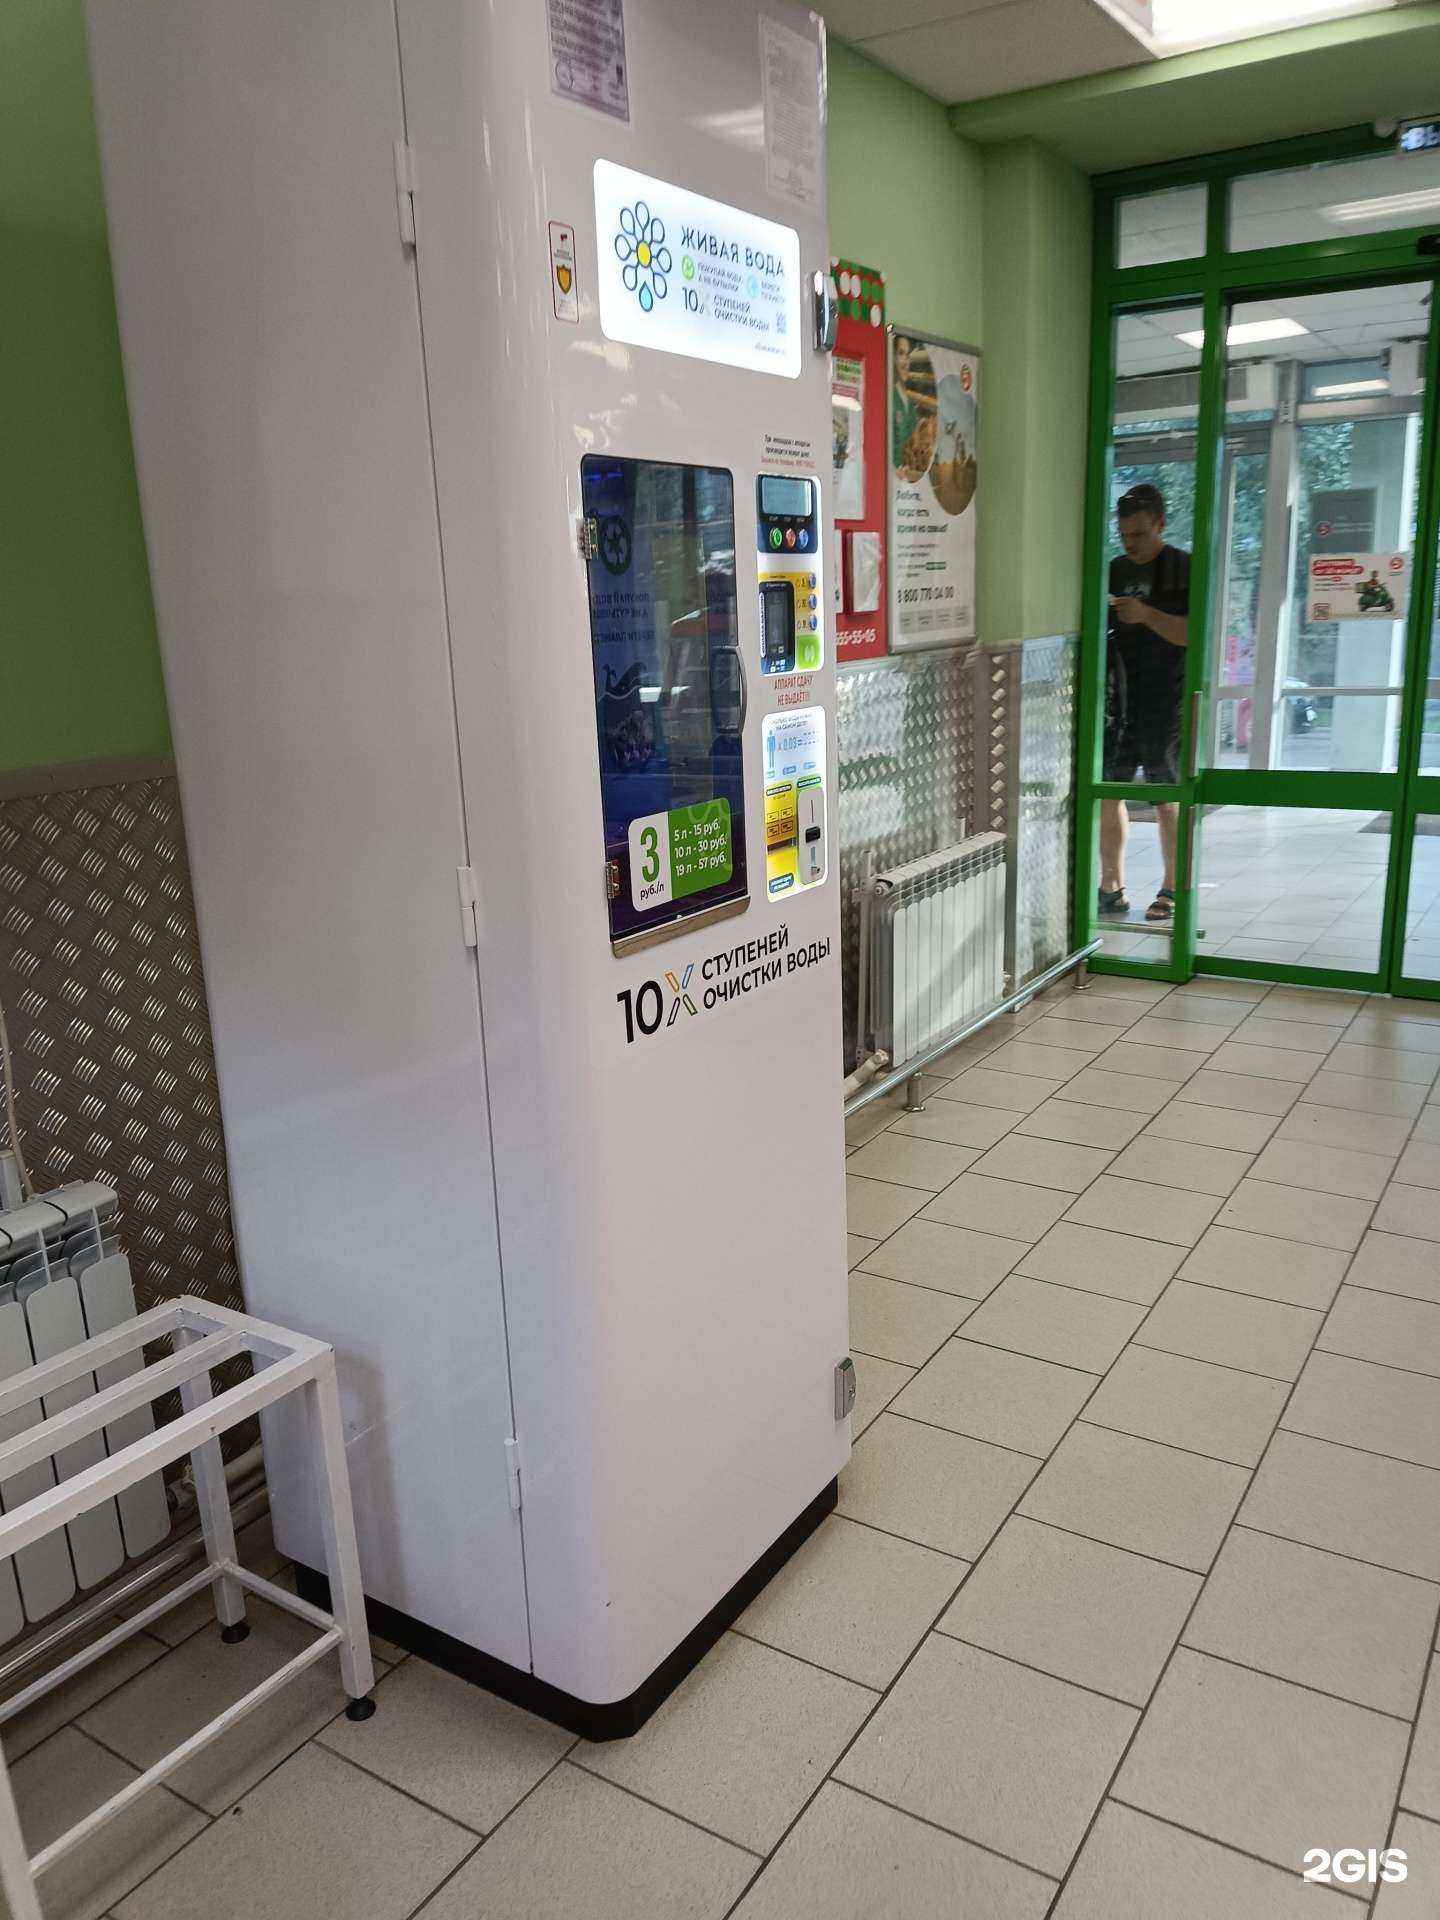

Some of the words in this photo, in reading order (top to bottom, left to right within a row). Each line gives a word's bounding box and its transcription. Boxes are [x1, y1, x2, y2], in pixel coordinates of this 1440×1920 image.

[681, 225, 739, 263] ЖИВАЯ
[745, 246, 785, 277] ВОДА
[674, 829, 680, 841] 5
[681, 829, 688, 840] л
[693, 823, 702, 836] 15
[703, 818, 721, 836] руб.
[675, 846, 685, 859] 10
[685, 846, 692, 856] л
[698, 839, 708, 852] 30
[709, 833, 727, 851] руб.
[640, 826, 660, 883] 3
[676, 864, 685, 877] 19
[685, 863, 692, 874] л
[698, 856, 708, 870] 57
[709, 851, 727, 869] руб.
[640, 881, 665, 900] руб./л
[701, 923, 789, 981] СТУПЕНЕЙ
[703, 958, 782, 1009] ОЧИСТКИ
[786, 937, 830, 973] ВОДЫ
